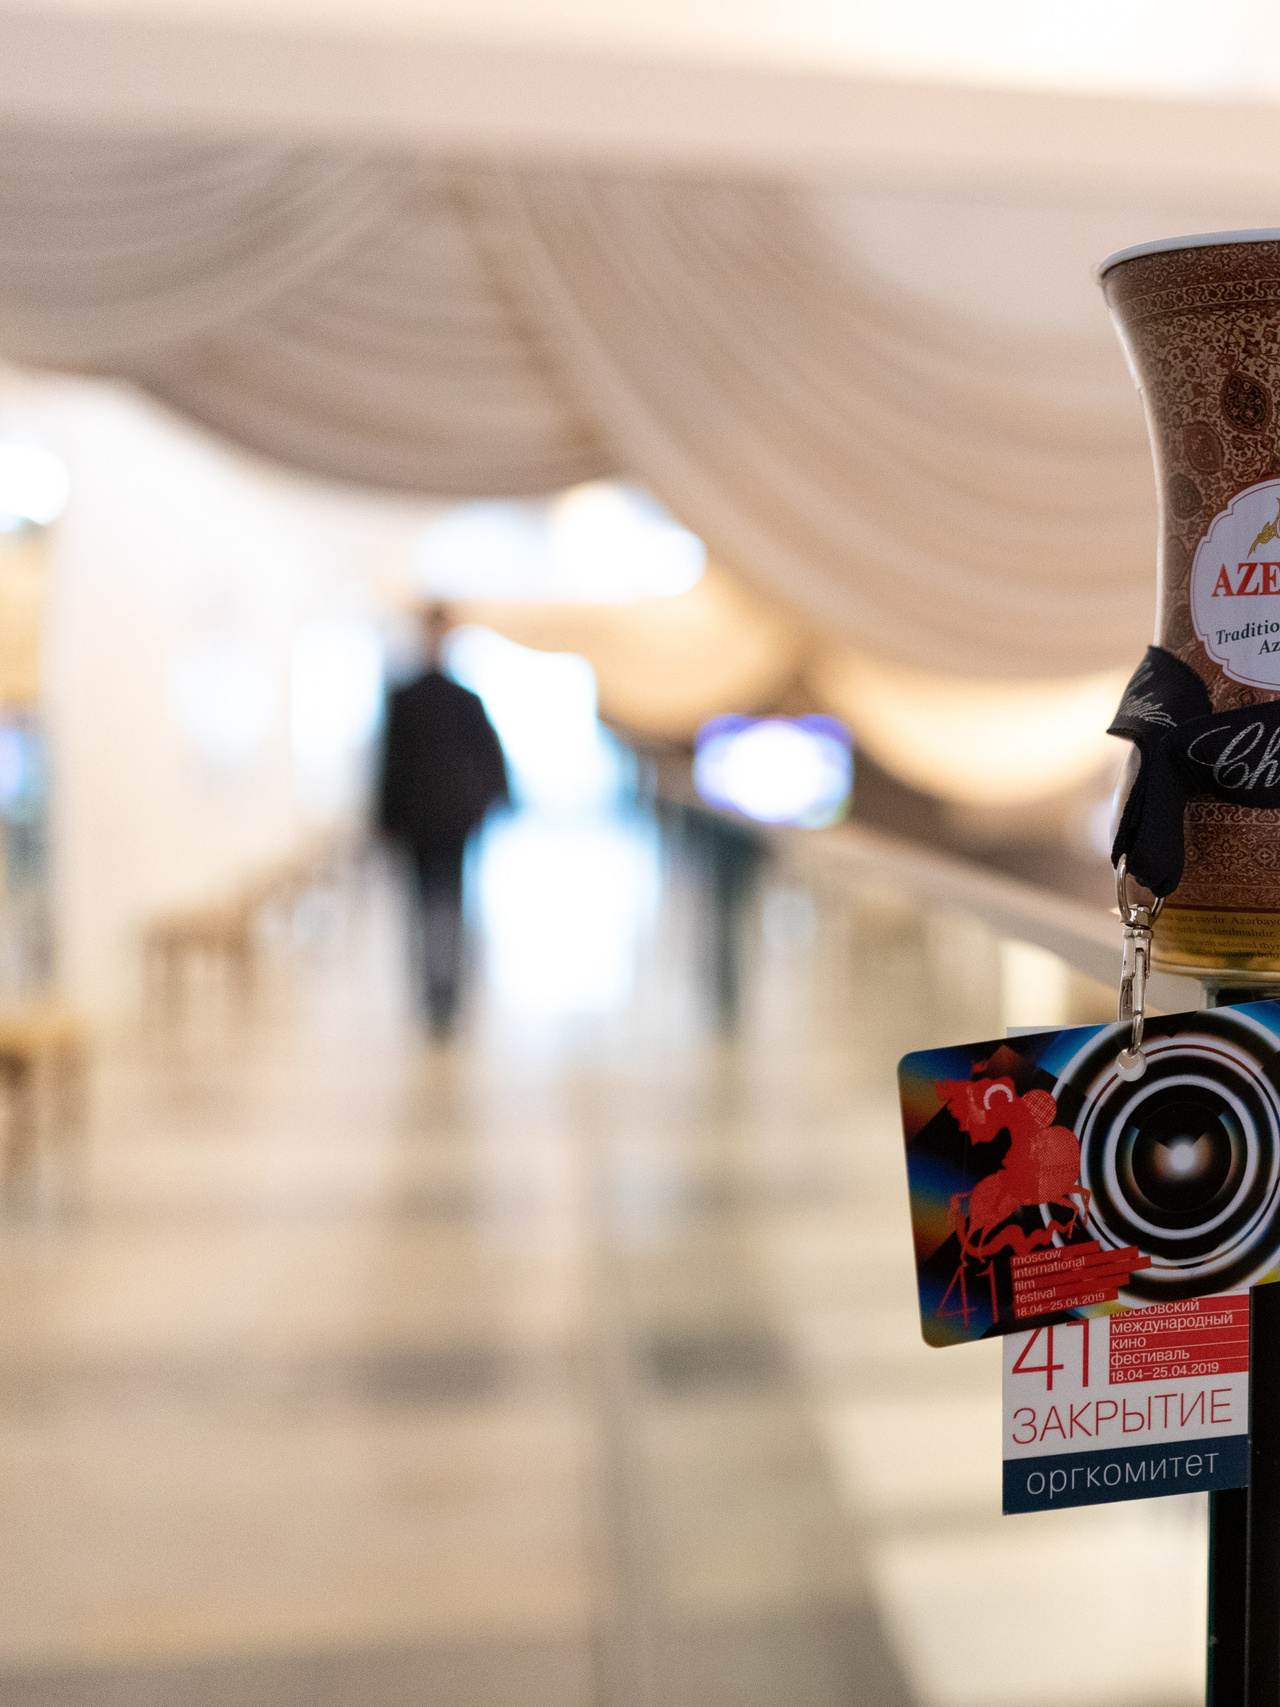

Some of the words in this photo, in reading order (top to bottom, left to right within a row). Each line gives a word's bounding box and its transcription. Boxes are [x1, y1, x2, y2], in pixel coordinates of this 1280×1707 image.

[1012, 1249, 1062, 1266] moscow
[1013, 1256, 1086, 1280] international
[1014, 1279, 1035, 1291] film
[1015, 1286, 1057, 1304] festival
[1112, 1311, 1233, 1335] международный
[1111, 1336, 1147, 1349] кино
[1111, 1349, 1190, 1367] фестиваль
[1012, 1388, 1233, 1445] ЗАКРЫТИЕ
[1026, 1452, 1220, 1499] оргкомитет
